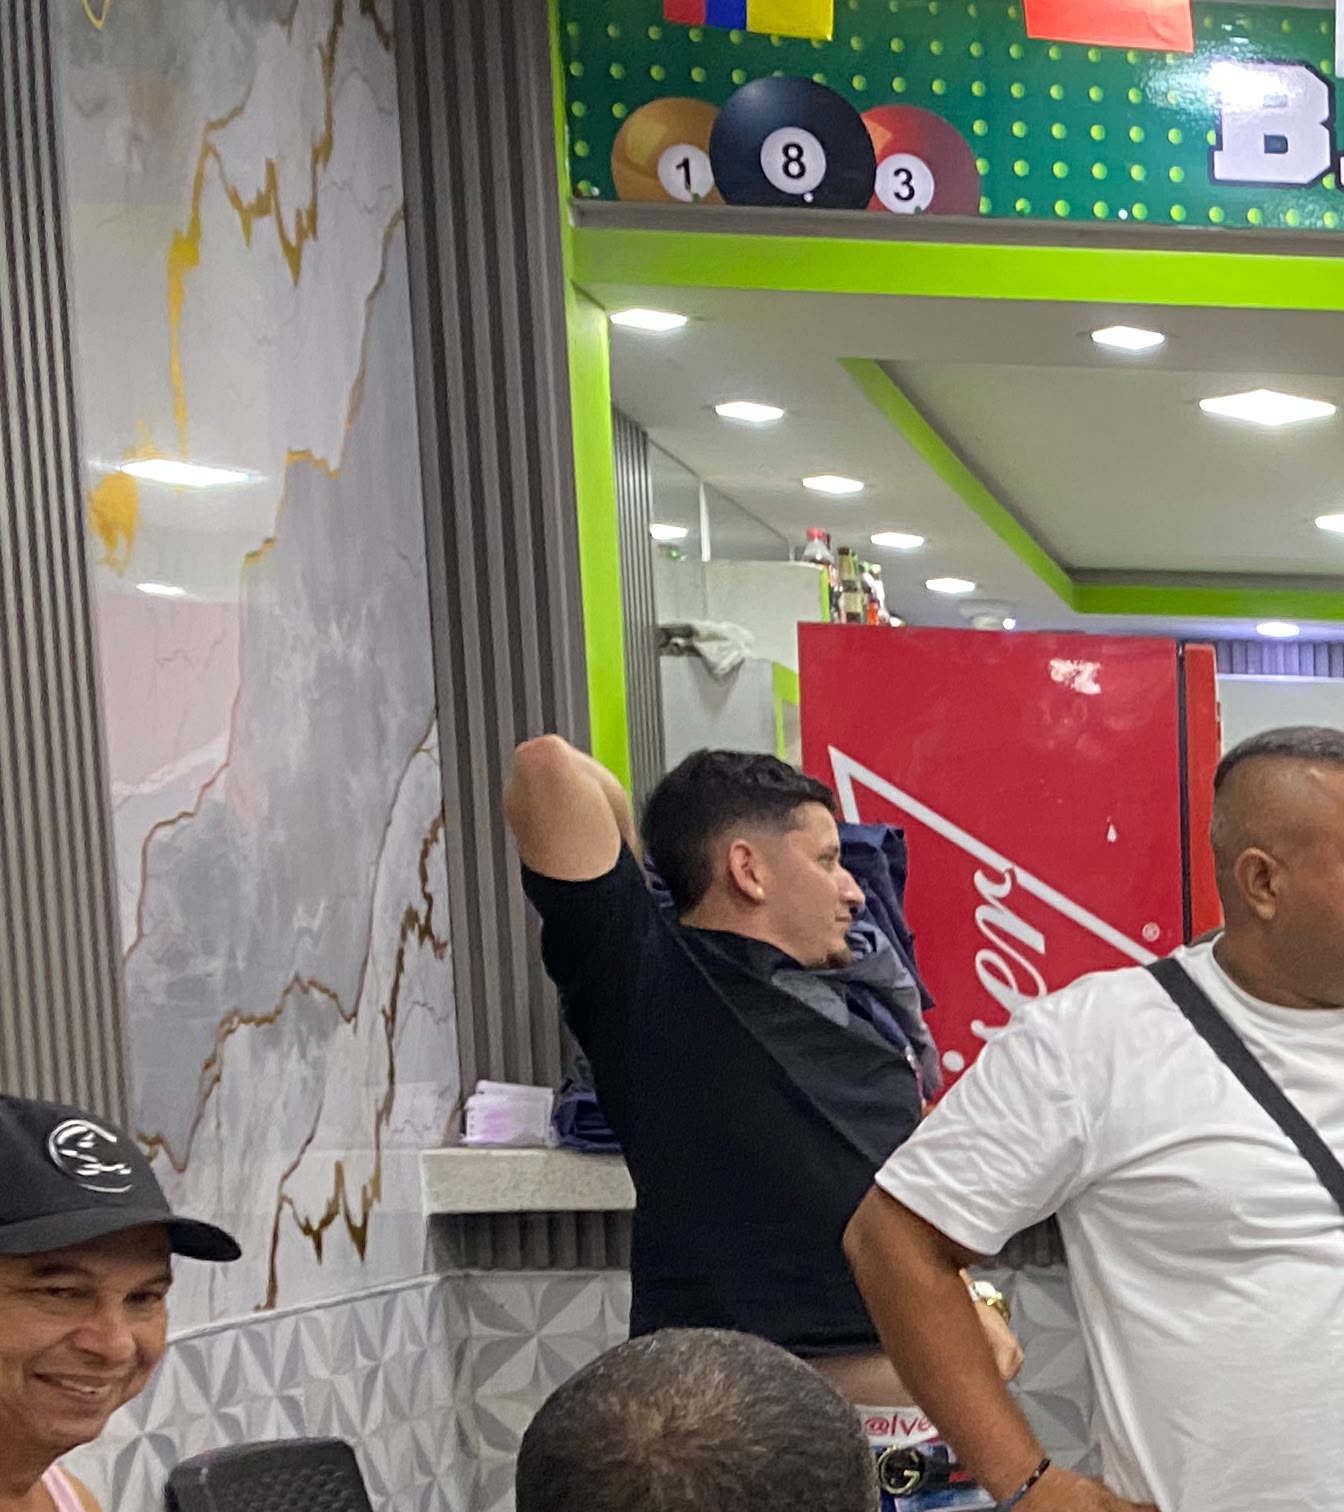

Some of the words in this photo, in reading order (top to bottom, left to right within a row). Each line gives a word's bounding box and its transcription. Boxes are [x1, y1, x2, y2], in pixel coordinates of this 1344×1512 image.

[675, 157, 691, 190] 1
[782, 143, 806, 179] 8
[893, 168, 915, 201] 3
